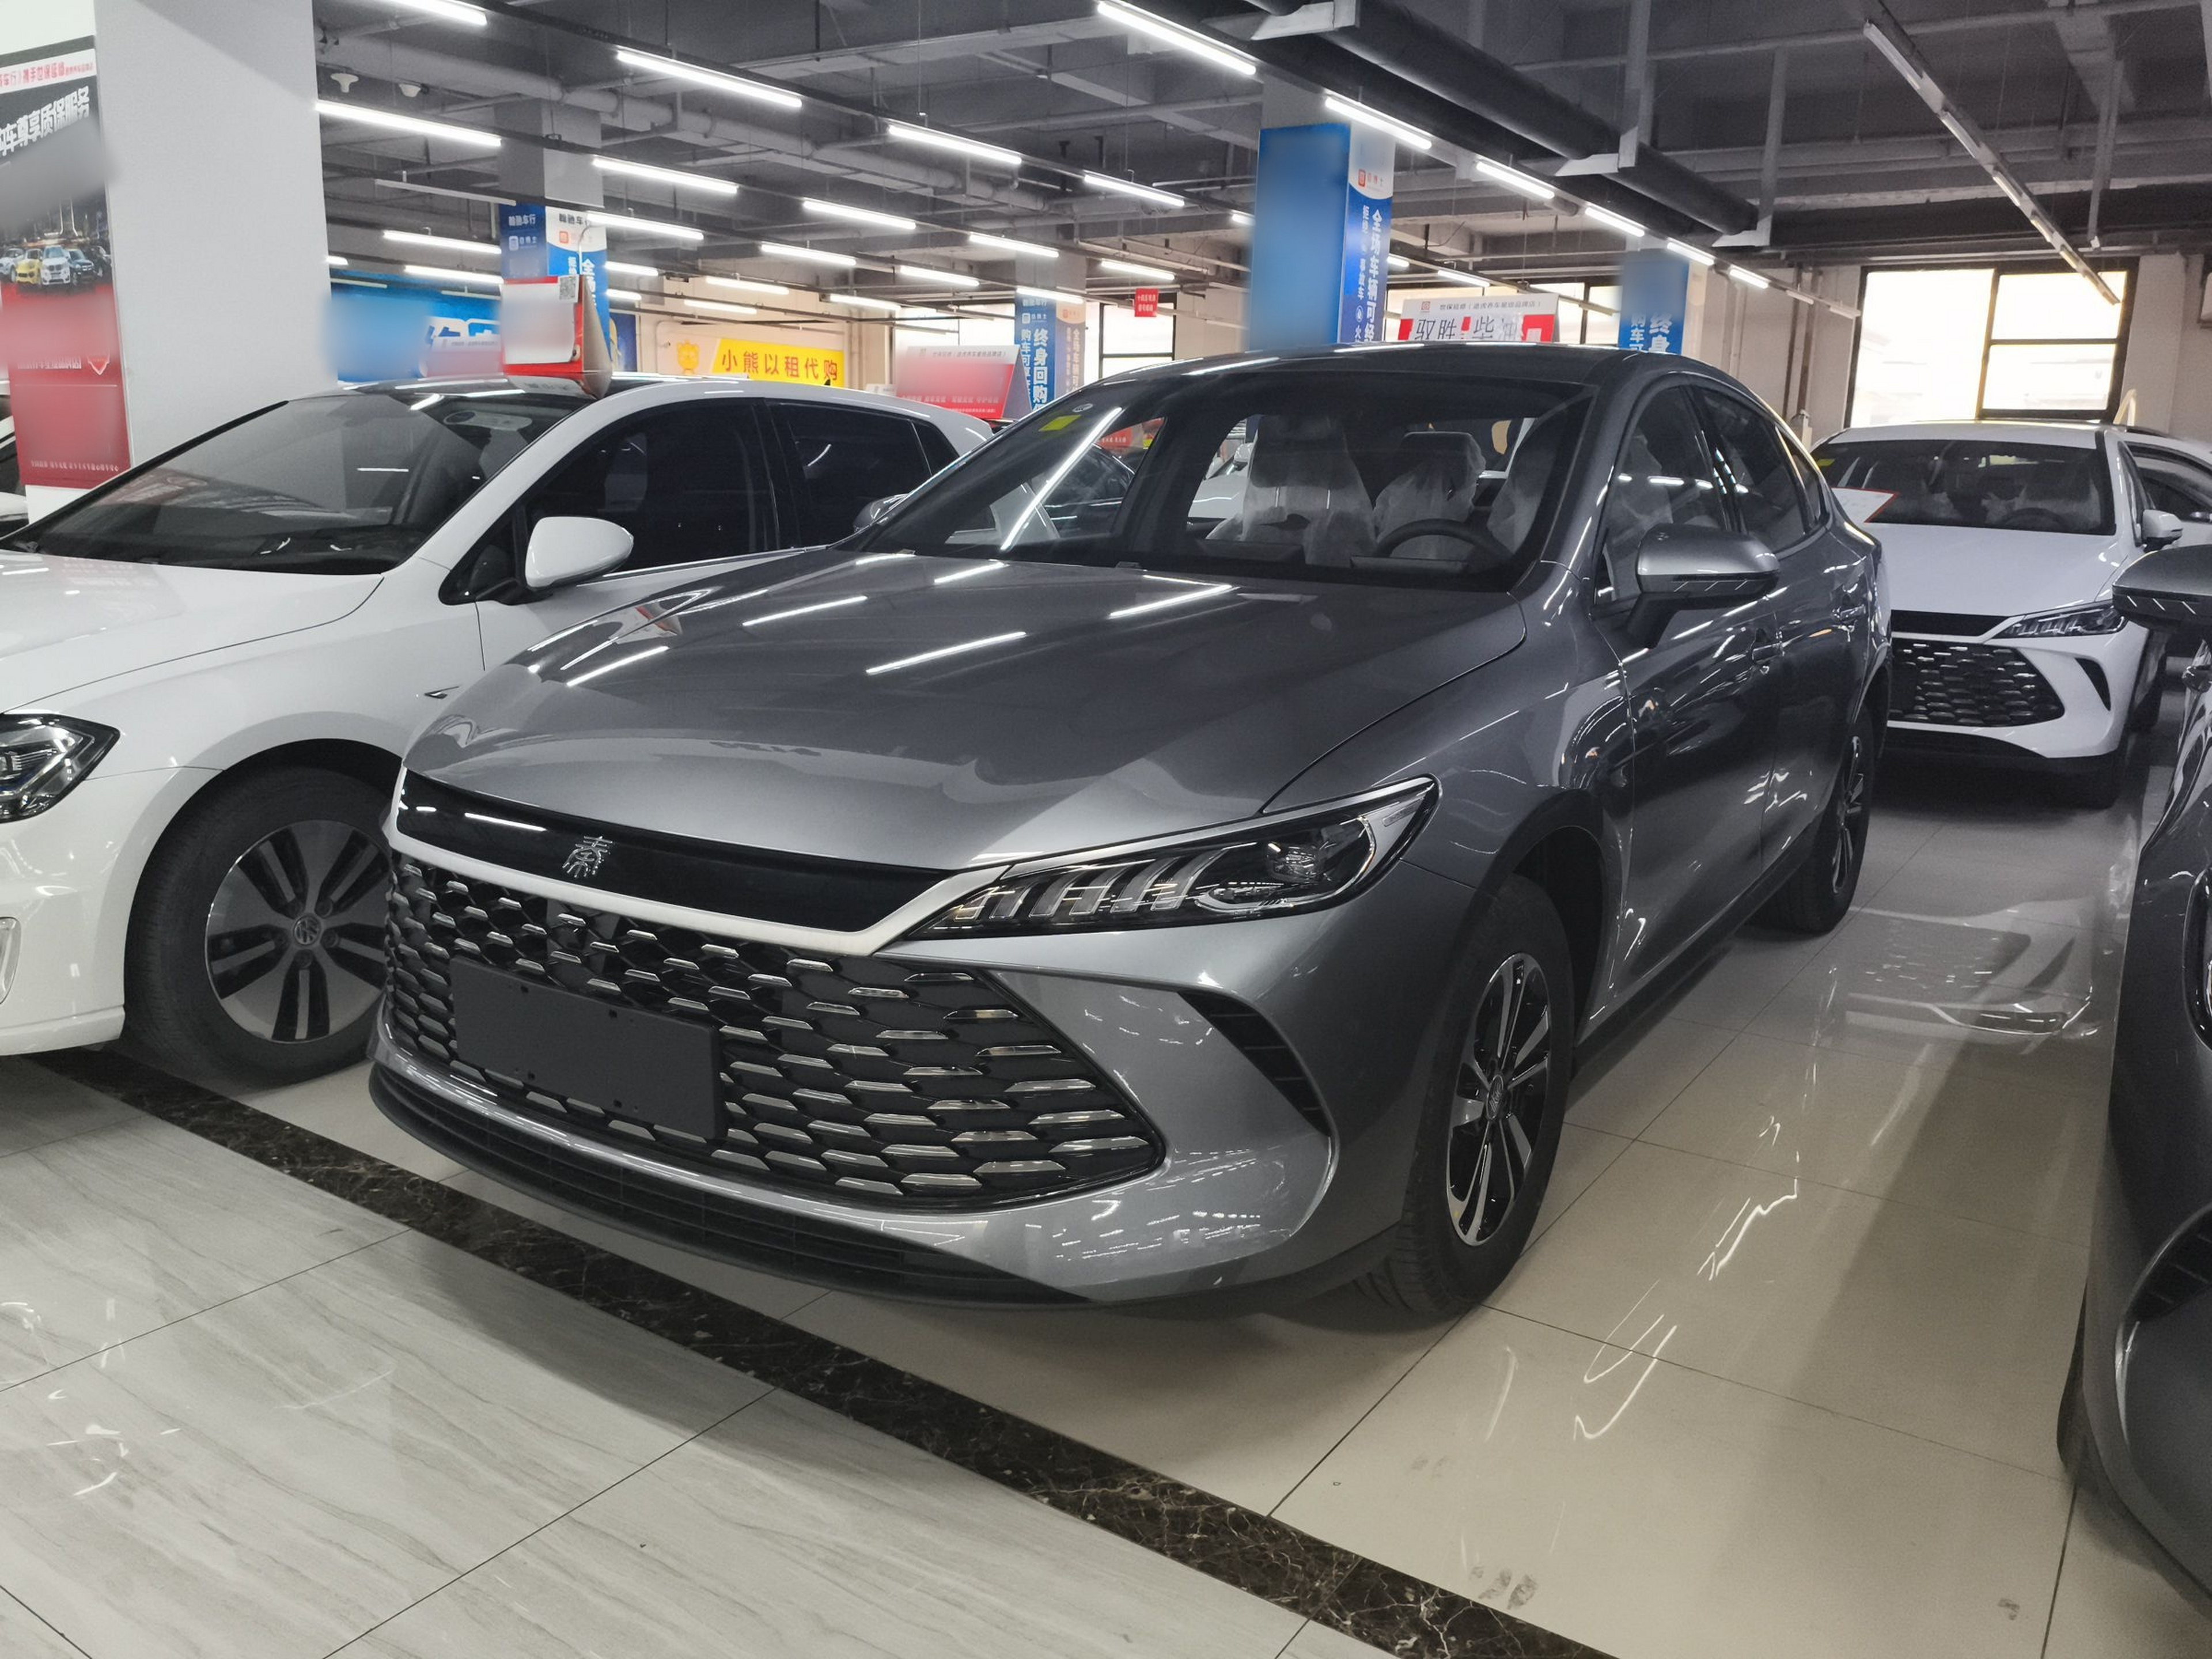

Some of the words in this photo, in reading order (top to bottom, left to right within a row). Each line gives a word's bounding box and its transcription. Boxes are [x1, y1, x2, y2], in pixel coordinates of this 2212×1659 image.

[722, 349, 838, 381] 小熊以租代购
